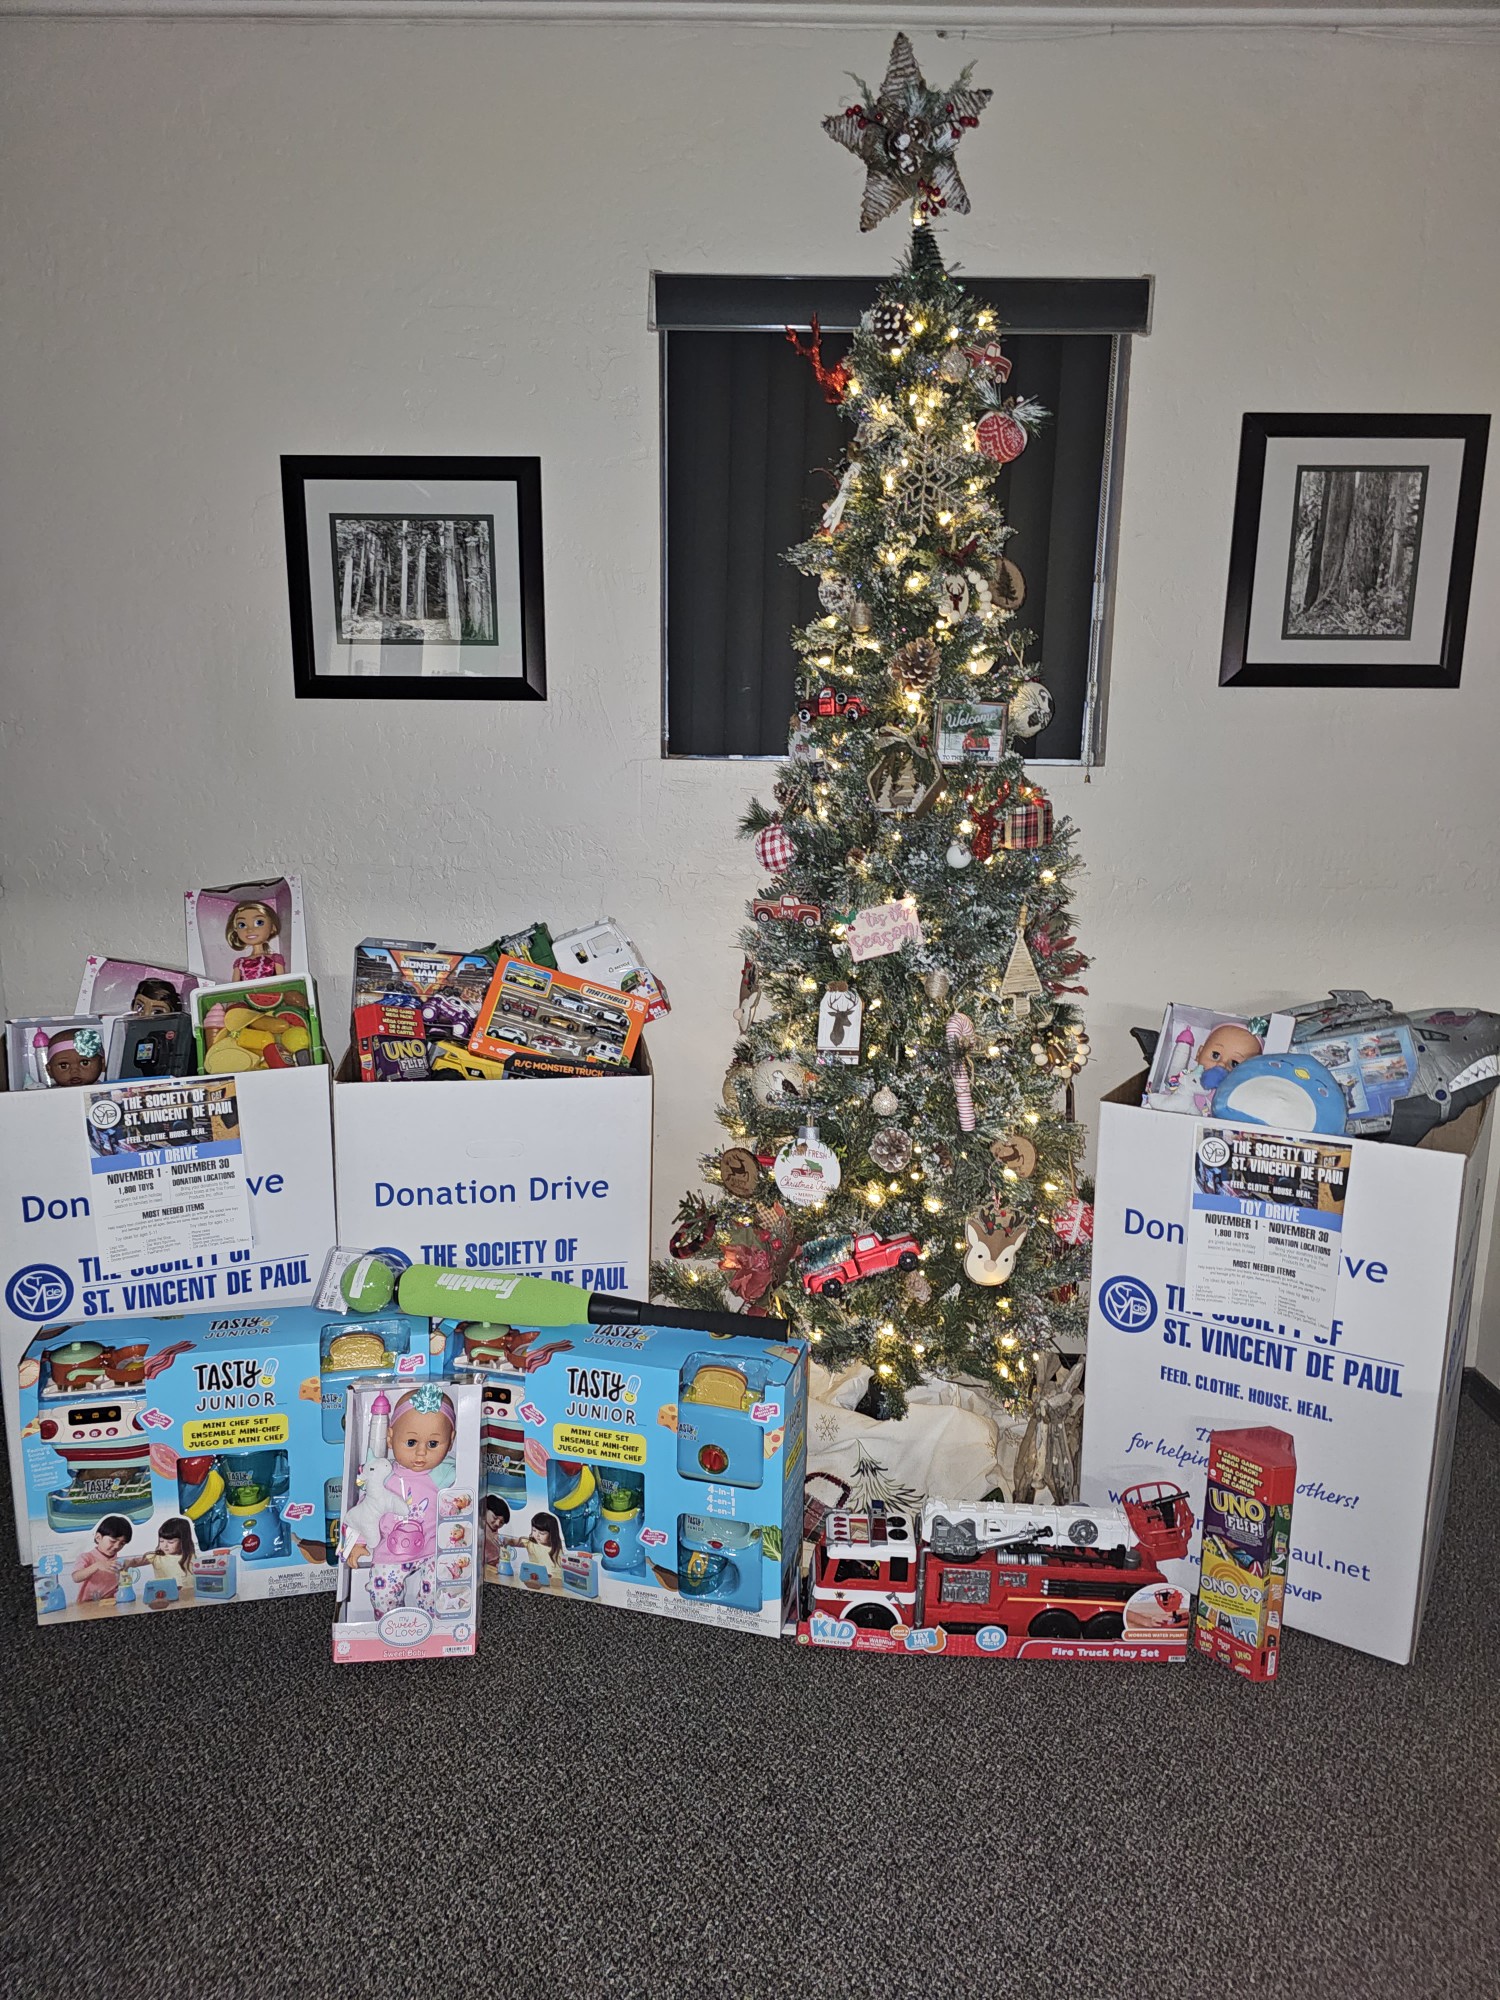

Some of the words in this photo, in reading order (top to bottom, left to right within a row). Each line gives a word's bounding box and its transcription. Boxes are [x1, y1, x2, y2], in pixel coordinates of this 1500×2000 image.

[945, 708, 999, 728] Welcome
[778, 908, 794, 919] Joy
[400, 960, 451, 971] MONSTER
[413, 969, 437, 977] JAM
[585, 987, 630, 1007] MATCHBOX
[383, 1039, 426, 1060] UNO
[400, 1057, 429, 1070] FLIP!
[514, 1059, 532, 1068] R/C
[532, 1062, 575, 1074] MONSTER
[575, 1067, 604, 1077] TRUCK
[122, 1096, 143, 1111] THE
[146, 1090, 186, 1109] SOCIETY
[192, 1089, 206, 1103] OF
[124, 1112, 141, 1127] ST.
[142, 1108, 189, 1125] VINCENT
[192, 1104, 206, 1118] DE
[208, 1101, 234, 1117] PAUL
[138, 1152, 163, 1167] TOY
[165, 1146, 199, 1163] DRIVE
[808, 1149, 828, 1160] FRESH
[1232, 1139, 1252, 1156] THE
[1255, 1142, 1300, 1161] SOCIETY
[1303, 1149, 1318, 1164] OF
[107, 1168, 155, 1185] NOVEMBER
[171, 1159, 217, 1176] NOVEMBER
[218, 1158, 231, 1169] 30
[172, 1175, 202, 1187] DONATION
[203, 1171, 236, 1183] LOCATIONS
[1231, 1156, 1247, 1172] ST.
[1249, 1158, 1296, 1179] VINCENT
[1301, 1165, 1314, 1181] DE
[1317, 1167, 1344, 1186] PAUL
[138, 1182, 155, 1193] TOYS
[375, 1179, 516, 1207] Donation
[529, 1176, 609, 1202] Drive
[780, 1175, 814, 1190] Christmas
[142, 1209, 160, 1220] MOST
[162, 1205, 185, 1217] NEEDED
[185, 1202, 205, 1214] ITEMS
[1240, 1199, 1262, 1216] TOY
[1265, 1202, 1300, 1223] DRIVE
[1205, 1213, 1252, 1229] NOVEMBER
[1268, 1221, 1316, 1240] NOVEMBER
[1318, 1230, 1329, 1243] 30
[1233, 1229, 1250, 1241] TOYS
[421, 1244, 458, 1268] THE
[465, 1240, 548, 1267] SOCIETY
[555, 1238, 578, 1262] OF
[1268, 1236, 1298, 1249] DONATION
[1300, 1241, 1331, 1257] LOCATIONS
[1232, 1259, 1251, 1270] MOST
[1252, 1262, 1275, 1274] NEEDED
[1276, 1266, 1297, 1279] ITEMS
[82, 1288, 115, 1317] ST.
[121, 1269, 219, 1312] VINCENT
[227, 1264, 252, 1295] DE
[260, 1259, 312, 1291] PAUL
[582, 1266, 629, 1292] PAUL
[204, 1328, 271, 1339] JUNIOR
[208, 1317, 263, 1331] TASTY
[593, 1324, 644, 1340] TASTY
[584, 1336, 645, 1351] JUNIOR
[1163, 1318, 1191, 1348] ST.
[1201, 1326, 1298, 1373] VINCENT
[1306, 1350, 1335, 1382] DE
[1343, 1358, 1403, 1398] PAUL
[194, 1360, 262, 1391] TASTY
[567, 1367, 626, 1402] TASTY
[196, 1392, 275, 1412] JUNIOR
[1160, 1365, 1191, 1387] FEED.
[1195, 1373, 1244, 1401] CLOTHE.
[1248, 1386, 1292, 1413] HOUSE.
[1297, 1400, 1334, 1423] HEAL.
[202, 1420, 226, 1429] MINI
[229, 1418, 251, 1427] CHEF
[253, 1417, 269, 1425] SET
[566, 1402, 636, 1425] JUNIOR
[188, 1439, 220, 1448] JUEGO
[222, 1437, 234, 1445] DE
[237, 1435, 261, 1444] MINI
[263, 1433, 284, 1442] CHEF
[190, 1429, 236, 1439] ENSEMBLE
[239, 1425, 281, 1435] MINI-CHEF
[570, 1427, 592, 1437] MINI
[594, 1431, 613, 1440] CHEF
[615, 1434, 630, 1443] SET
[557, 1444, 585, 1454] JUEGO
[587, 1448, 598, 1456] DE
[600, 1450, 621, 1459] MINI
[623, 1453, 643, 1462] CHEF
[560, 1435, 600, 1447] ENSEMBLE
[602, 1441, 640, 1453] MINI-CHEF
[1125, 1432, 1154, 1454] for
[1155, 1437, 1210, 1470] helpin
[1295, 1481, 1360, 1510] others!
[1221, 1457, 1239, 1469] MEGA
[1222, 1450, 1240, 1462] CARD
[1240, 1460, 1263, 1473] GAMES
[1221, 1476, 1230, 1485] DE
[1231, 1481, 1256, 1497] CARTES
[1223, 1472, 1232, 1480] DE
[1238, 1478, 1255, 1489] JEUX
[1234, 1470, 1263, 1487] COFFRET
[706, 1484, 735, 1497] 4-in-1
[1209, 1487, 1266, 1522] UNO
[1226, 1515, 1264, 1537] FLIP!
[1200, 1574, 1239, 1599] ONO
[1240, 1583, 1262, 1605] 99
[384, 1616, 428, 1635] Sweet
[812, 1620, 855, 1639] KID
[911, 1632, 929, 1640] TRY
[982, 1632, 1001, 1643] 10
[383, 1650, 405, 1658] Sweet
[407, 1649, 426, 1658] Baby
[1051, 1647, 1074, 1657] Fire
[1076, 1648, 1110, 1658] Truck
[1112, 1648, 1137, 1660] Play
[1140, 1648, 1160, 1658] Set
